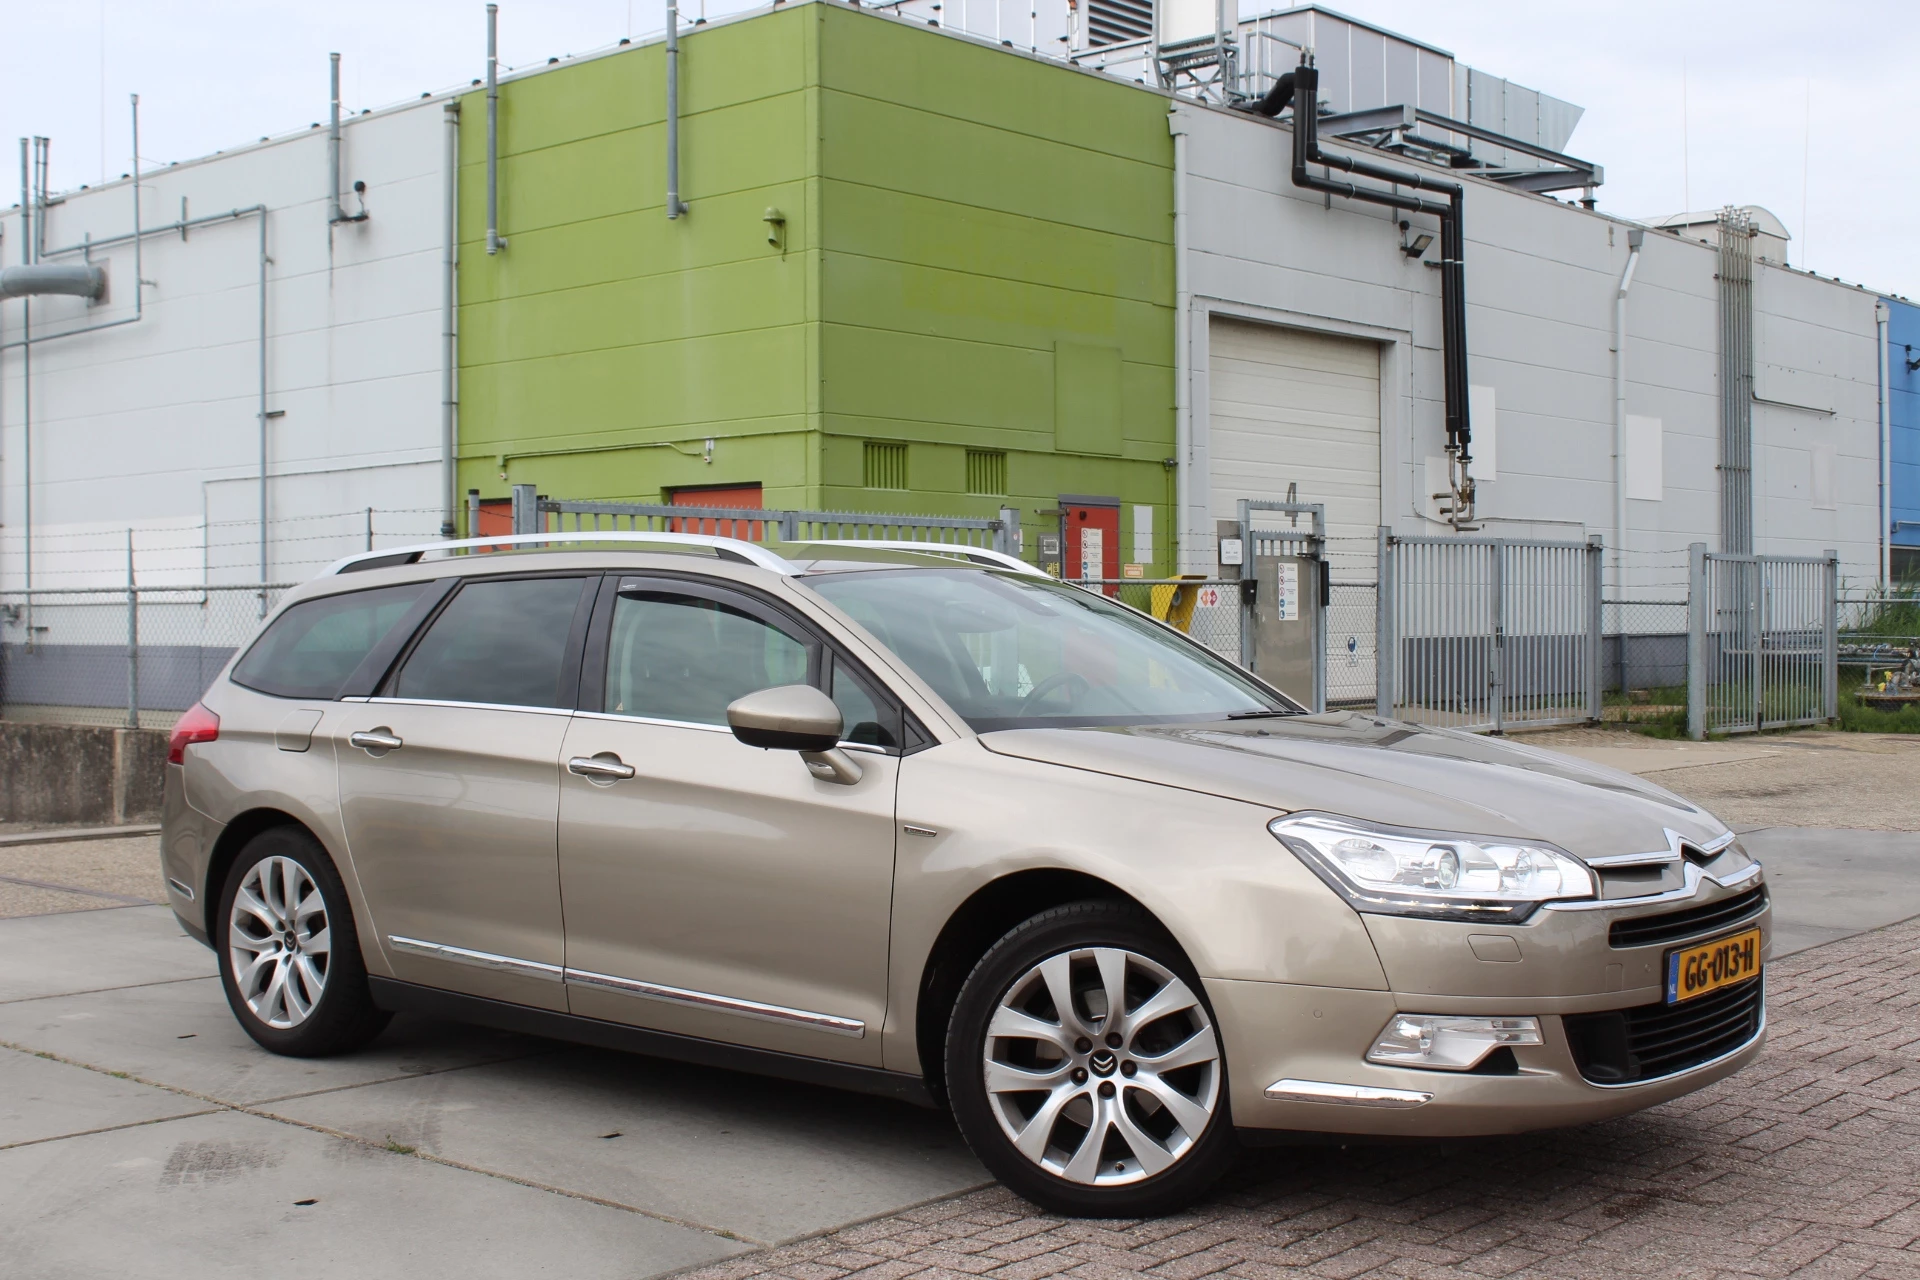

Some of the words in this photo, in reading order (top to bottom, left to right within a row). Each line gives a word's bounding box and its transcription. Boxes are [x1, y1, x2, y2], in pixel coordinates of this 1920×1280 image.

[1285, 482, 1298, 527] 4
[1685, 938, 1754, 991] GG-013-H
[1668, 983, 1676, 995] NL
